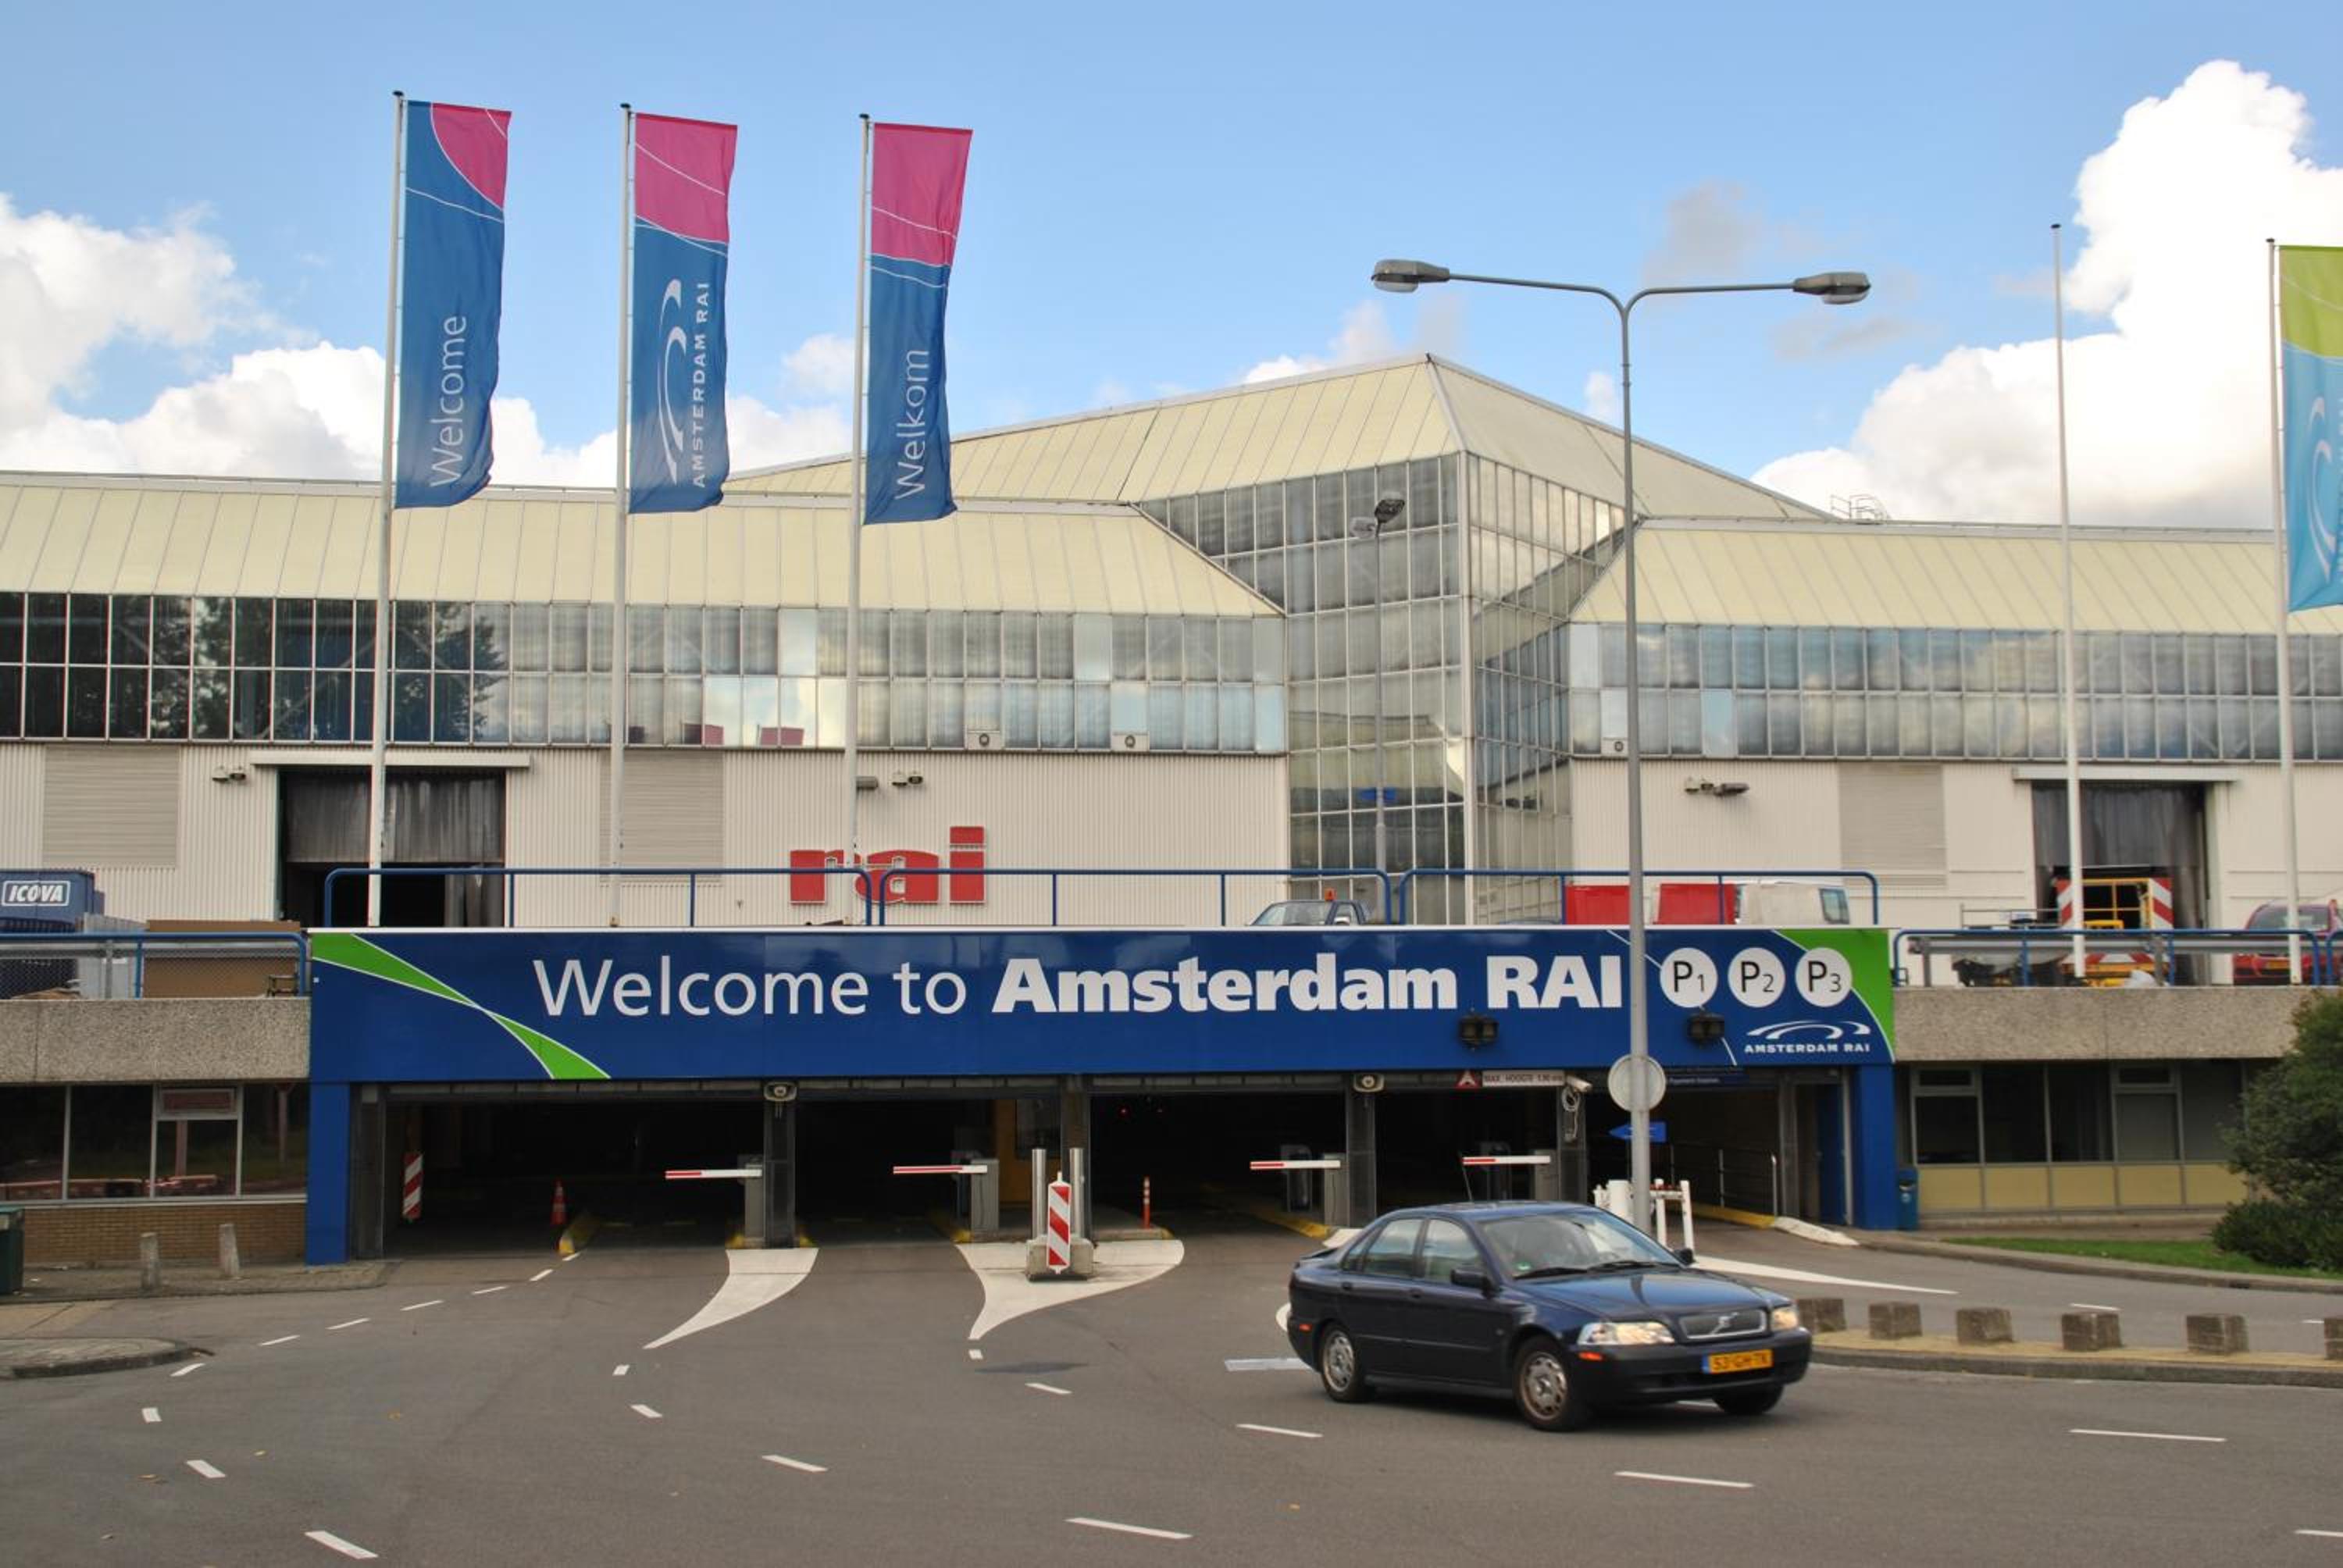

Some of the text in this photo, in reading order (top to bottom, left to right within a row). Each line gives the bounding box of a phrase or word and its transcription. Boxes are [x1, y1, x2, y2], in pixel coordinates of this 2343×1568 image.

[430, 315, 467, 487] Welcome
[692, 282, 710, 488] AMSTERDAM RAI
[895, 350, 929, 500] Welkom
[9, 885, 64, 903] ICOVA
[790, 825, 985, 903] rai
[533, 953, 1622, 1016] Welcome to Amsterdam RAI
[1744, 1043, 1870, 1053] AMSTERDAM RAI
